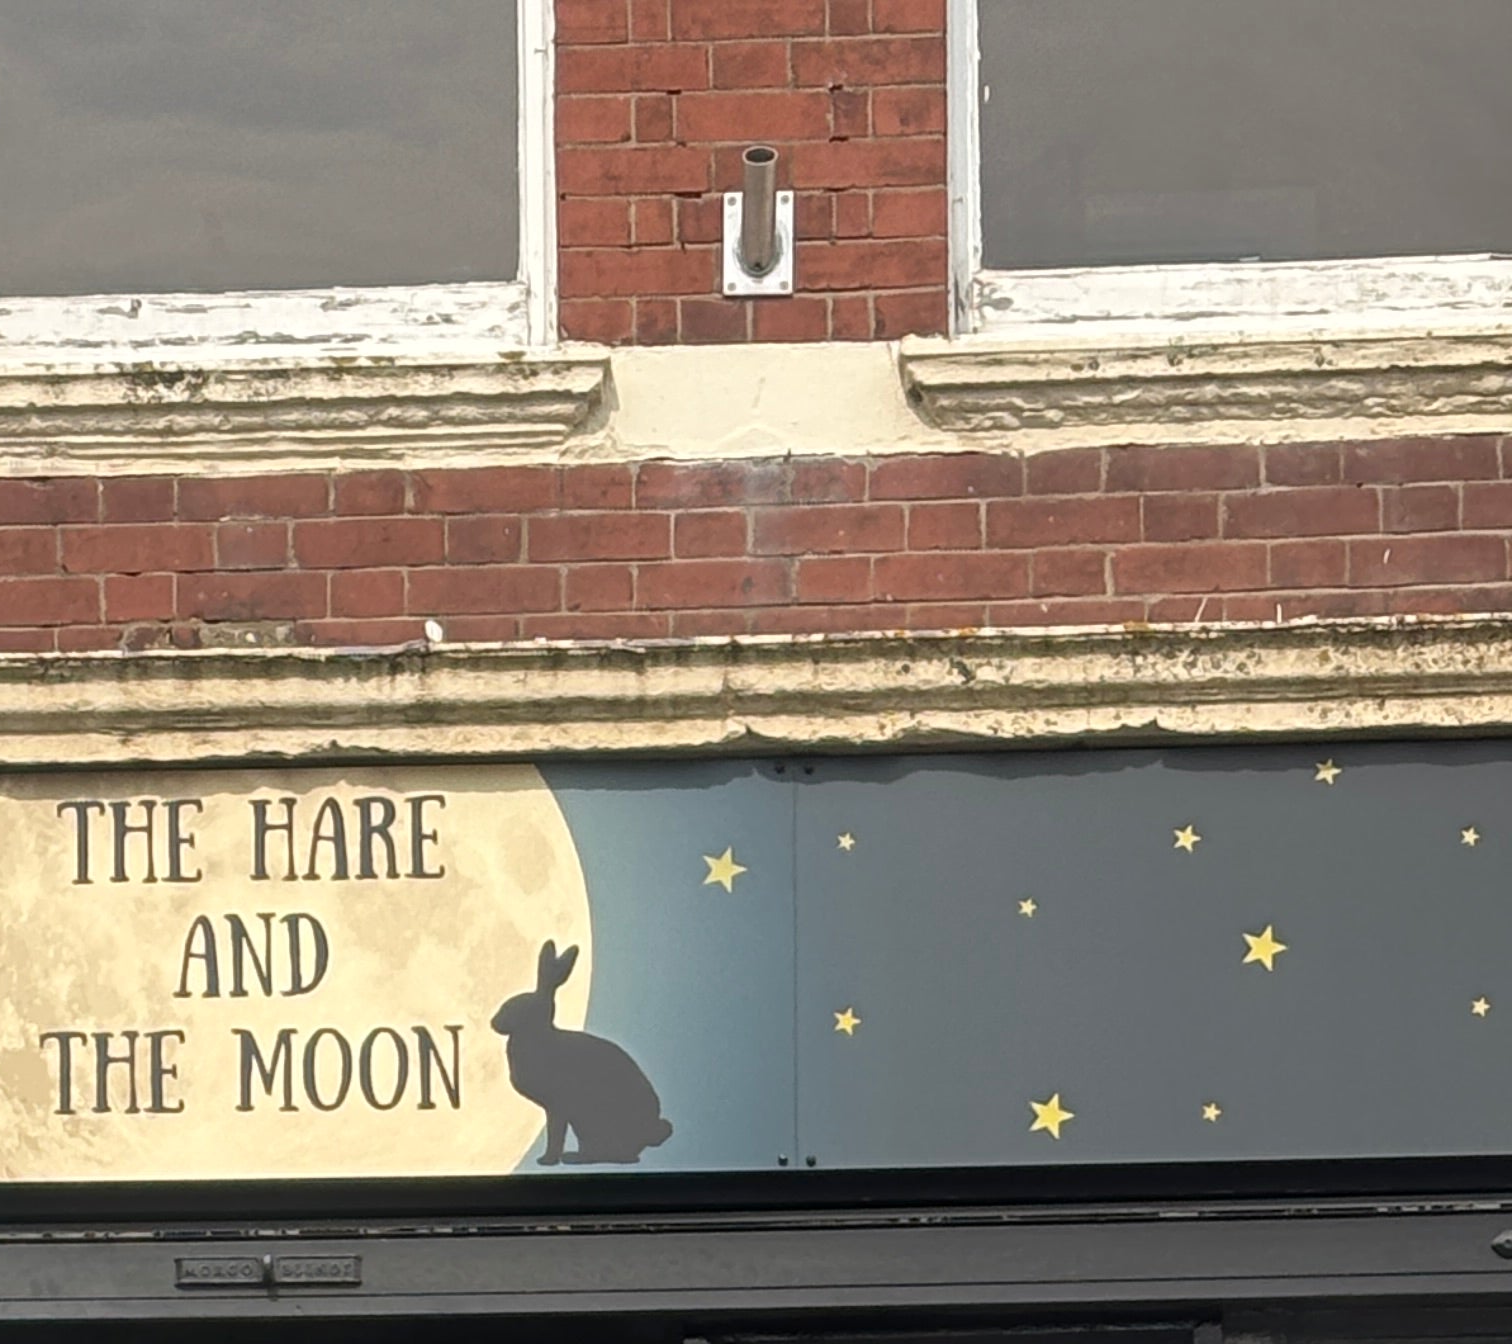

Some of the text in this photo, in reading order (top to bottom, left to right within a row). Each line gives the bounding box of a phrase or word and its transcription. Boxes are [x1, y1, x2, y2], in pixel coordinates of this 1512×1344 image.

[57, 794, 447, 885] THE HARE
[173, 912, 330, 998] AND
[40, 1024, 464, 1117] THE MOON
